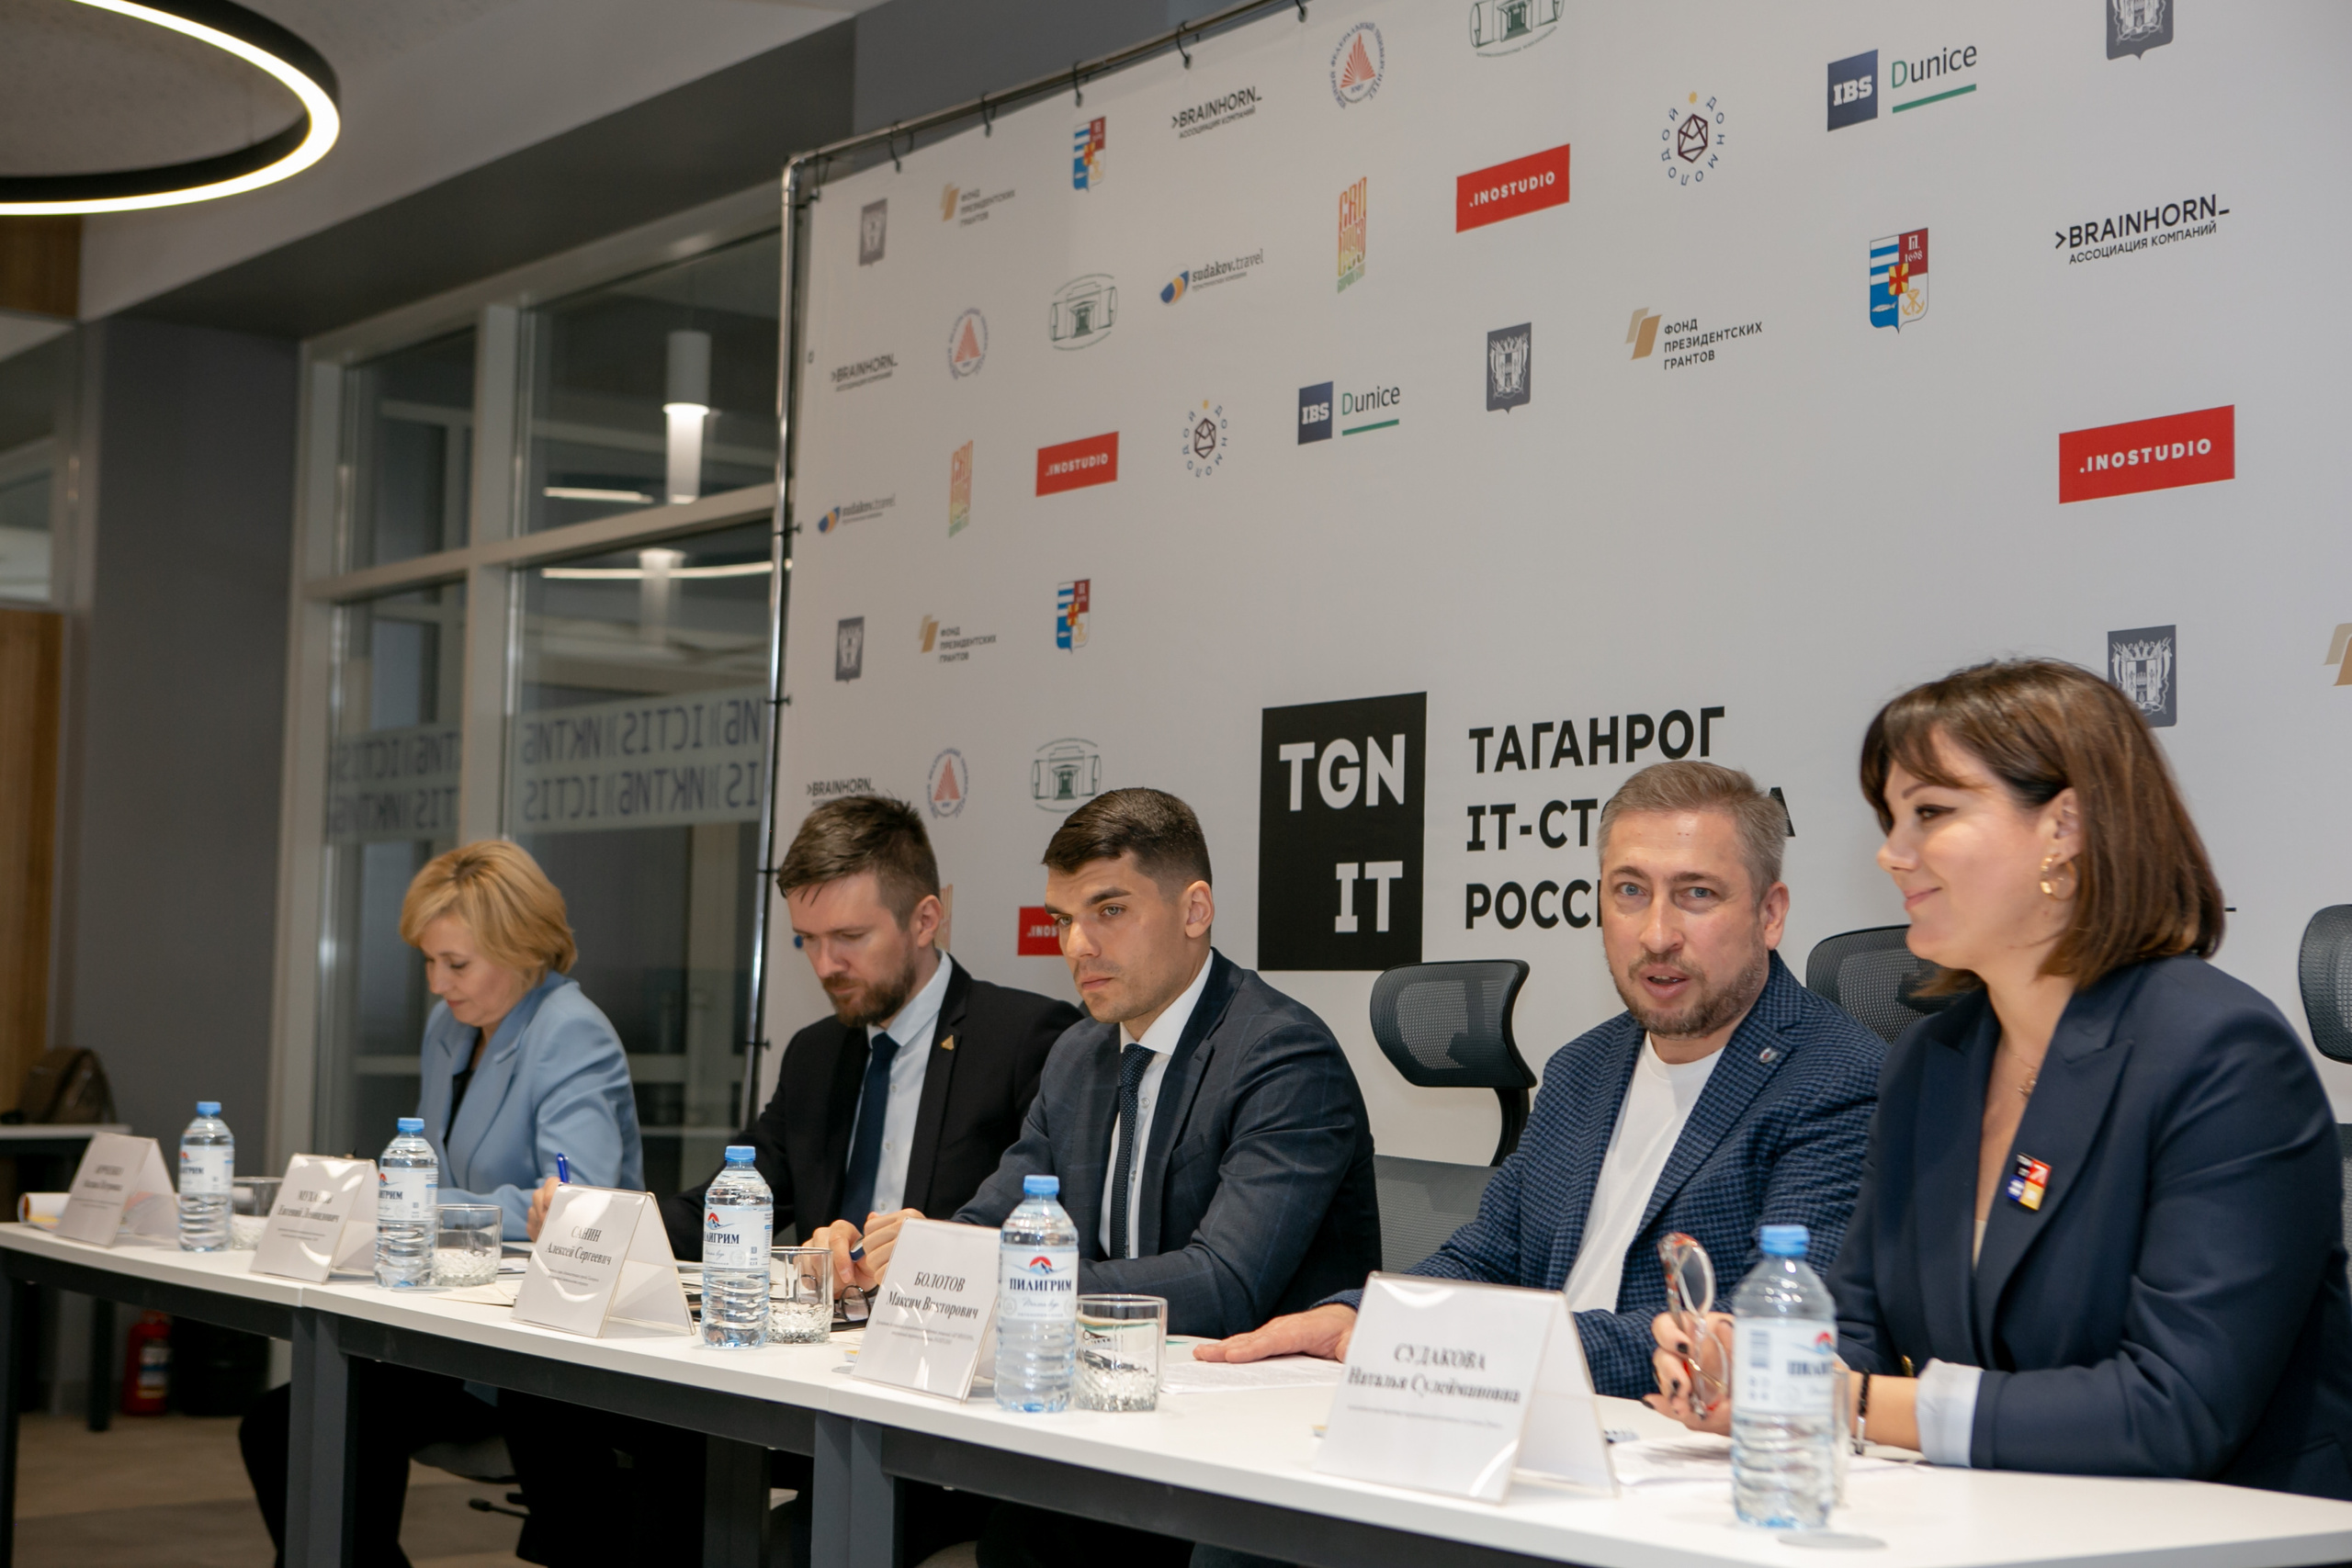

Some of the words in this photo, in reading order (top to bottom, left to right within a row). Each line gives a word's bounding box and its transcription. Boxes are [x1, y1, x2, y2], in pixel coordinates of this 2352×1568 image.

[1833, 74, 1873, 107] IBS
[1892, 45, 1977, 89] Dunice
[2069, 237, 2148, 265] АССОЦИАЦИЯ
[2151, 220, 2217, 247] КОМПАНИЙ
[1193, 248, 1264, 283] sudakov.travel
[1664, 318, 1698, 335] ФОНД
[1664, 321, 1763, 353] ПРЕЗИДЕНТСКИХ
[1664, 350, 1715, 370] ГРАНТОВ
[1301, 401, 1329, 425] IBS
[1341, 385, 1400, 416] Dunice
[1468, 706, 1725, 774] ТАГАНРОГ
[1279, 733, 1406, 811] TGN
[1335, 861, 1403, 933] IT
[1465, 879, 1602, 931] РОСС
[1026, 925, 1058, 938] .INOS
[571, 1225, 603, 1243] САНИН
[704, 1232, 741, 1245] ЛИГРИМ
[545, 1242, 575, 1258] Алексей
[574, 1246, 613, 1266] Сергеевич
[913, 1271, 966, 1292] БОЛОТОВ
[1009, 1278, 1072, 1292] ПИЛИГРИМ
[887, 1291, 922, 1310] Максим
[1393, 1343, 1487, 1371] СУДАКОВА
[1347, 1366, 1408, 1391] Наталья
